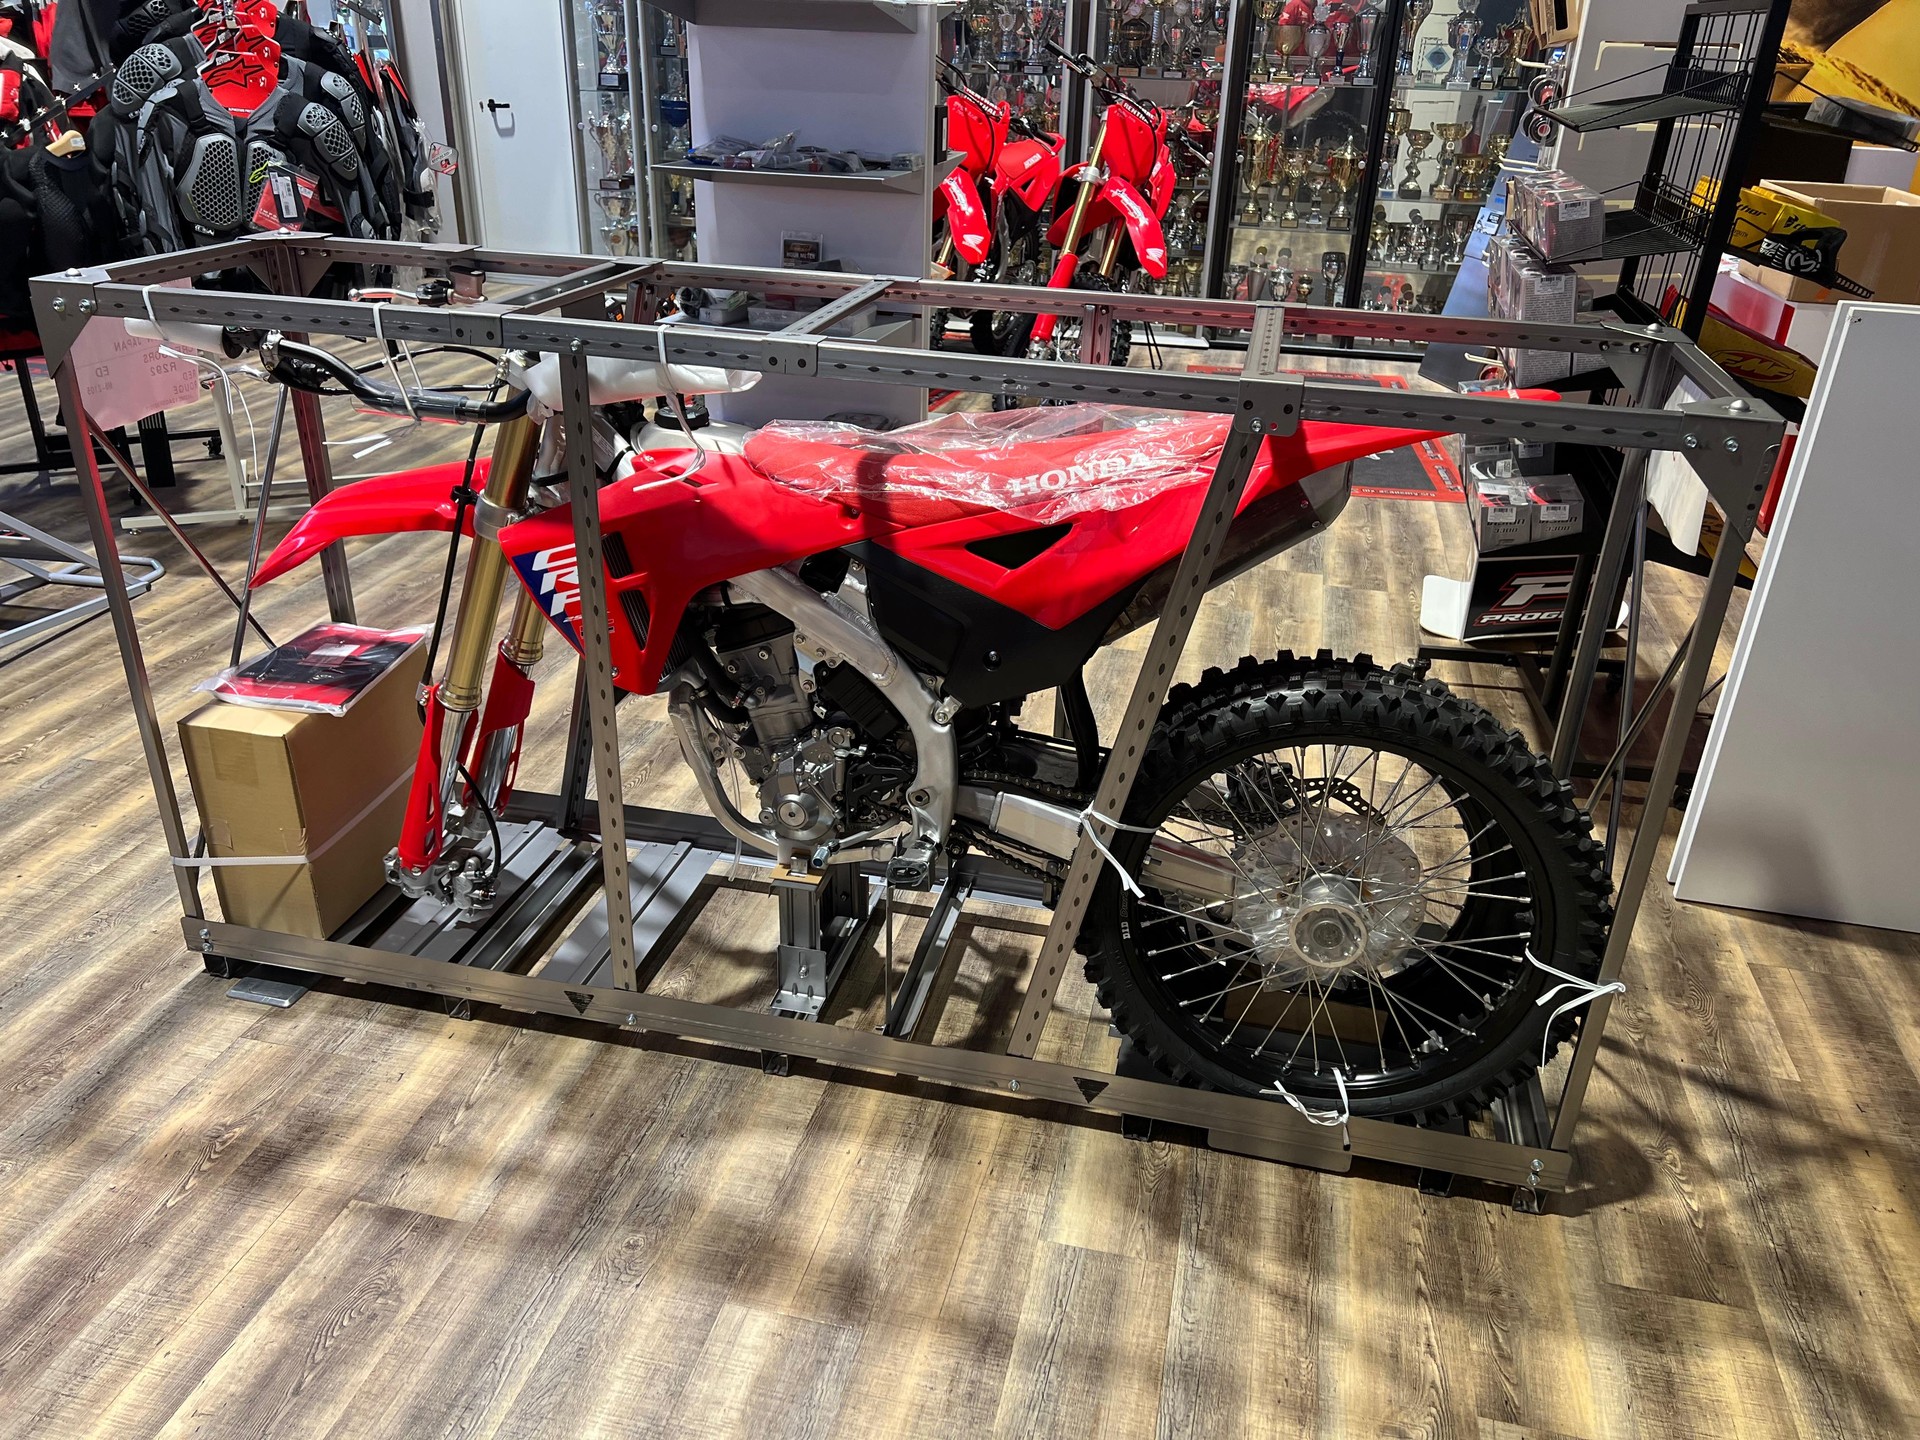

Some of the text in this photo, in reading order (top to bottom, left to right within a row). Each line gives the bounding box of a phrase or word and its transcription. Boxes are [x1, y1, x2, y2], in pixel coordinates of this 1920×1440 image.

[1712, 352, 1797, 377] FMF
[1009, 451, 1152, 498] HONDA
[1480, 610, 1566, 624] PROG
